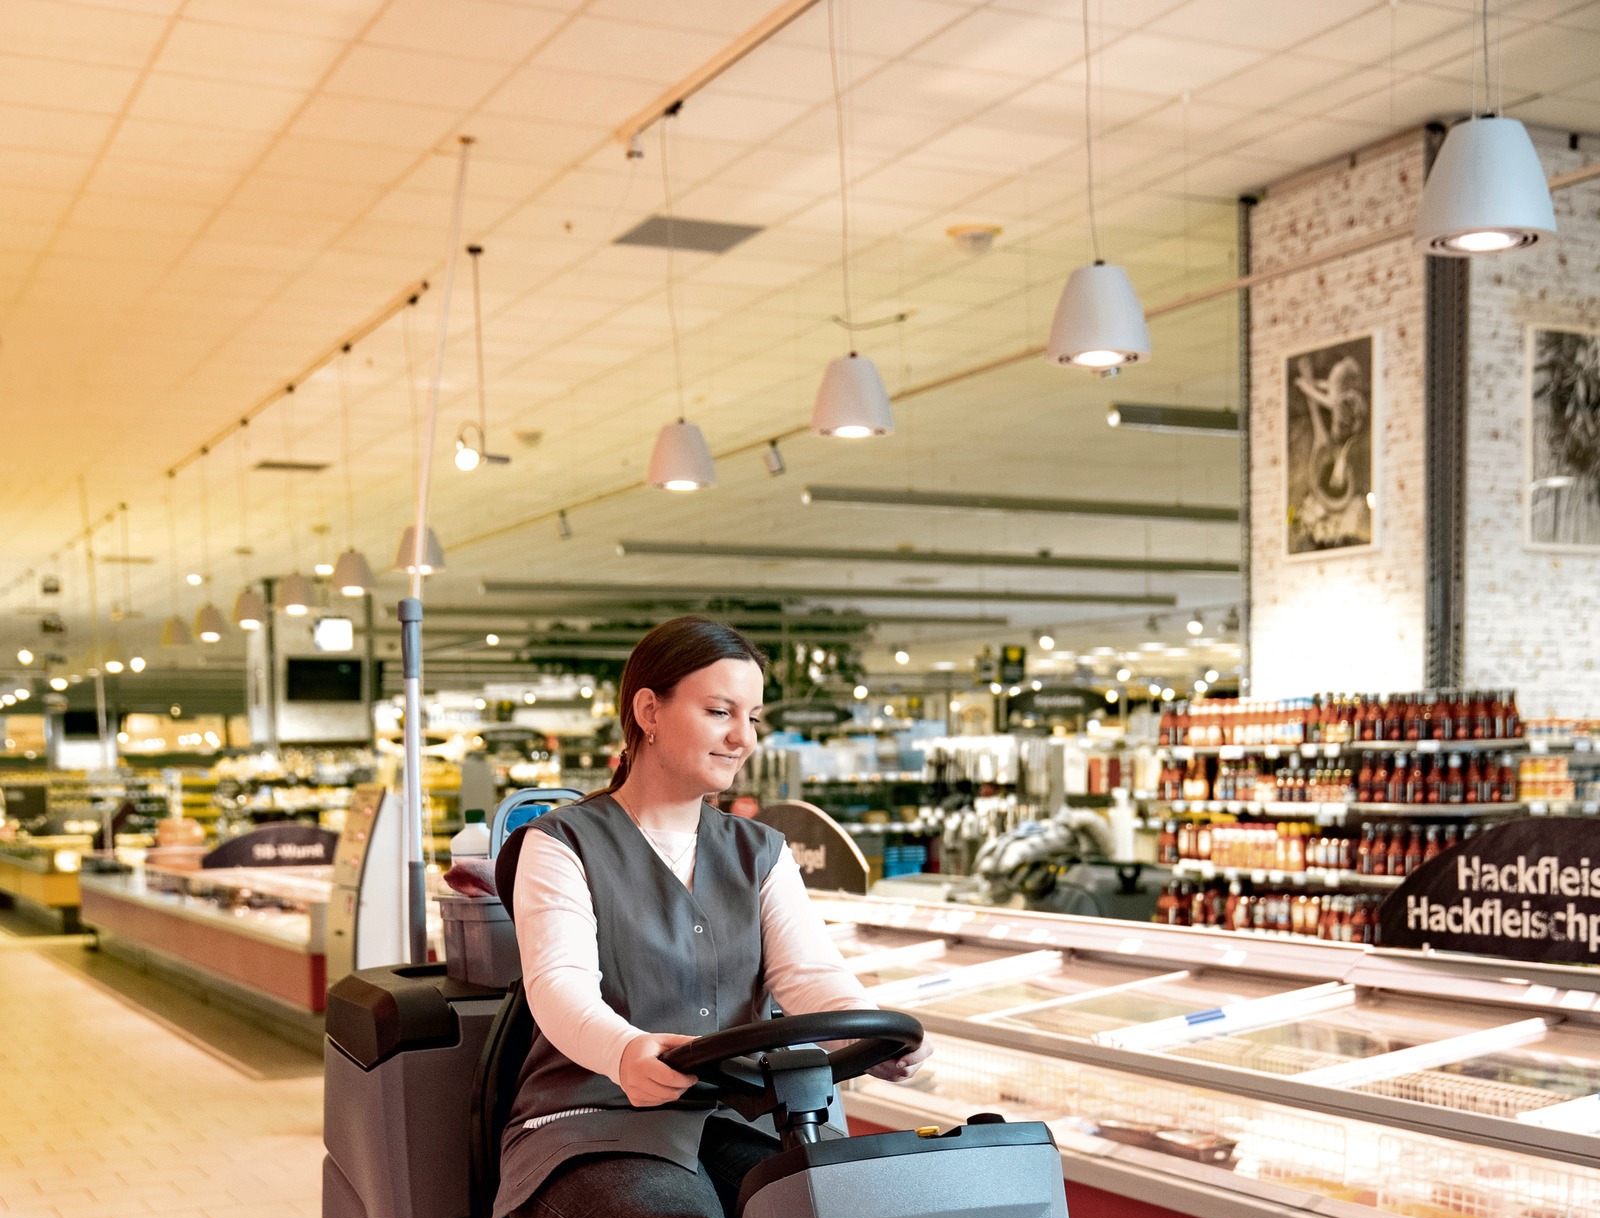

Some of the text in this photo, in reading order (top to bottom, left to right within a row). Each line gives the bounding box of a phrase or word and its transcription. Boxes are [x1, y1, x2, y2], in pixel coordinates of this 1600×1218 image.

[789, 842, 826, 873] lügel
[1457, 855, 1600, 898] Hackfleis
[1407, 895, 1600, 953] Hackfleischp
